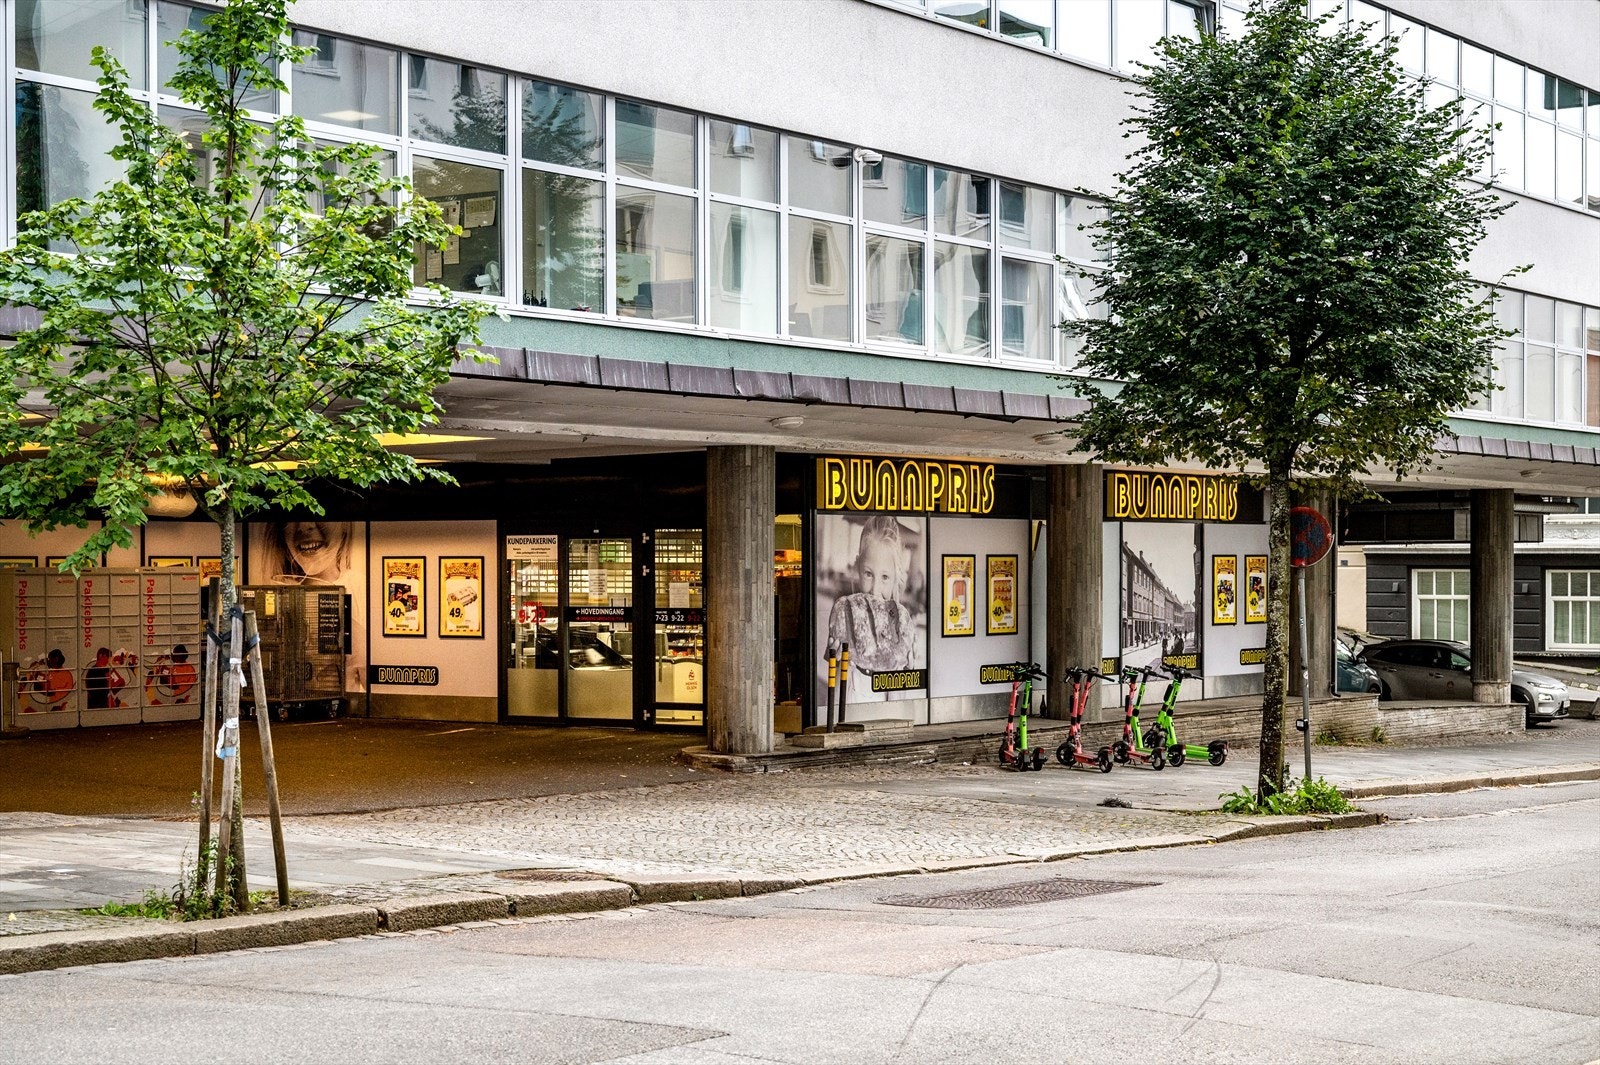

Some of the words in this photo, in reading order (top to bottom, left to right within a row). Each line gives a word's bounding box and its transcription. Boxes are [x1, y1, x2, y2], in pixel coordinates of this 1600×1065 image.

[825, 458, 995, 514] BUNNPRIS
[1115, 473, 1238, 520] BUNNPRIS
[507, 537, 556, 545] KUNDEPARKERING
[18, 580, 27, 650] Pakkeboks
[84, 580, 92, 648] Pakkeboks
[146, 579, 155, 645] Pakkeboks
[518, 609, 546, 623] 9-22
[580, 608, 625, 616] HOVEDINNGANG
[655, 614, 669, 622] 7-23
[671, 614, 685, 622] 9-22
[378, 667, 436, 684] BUNNPRIS
[873, 671, 920, 690] BUNNPRIS
